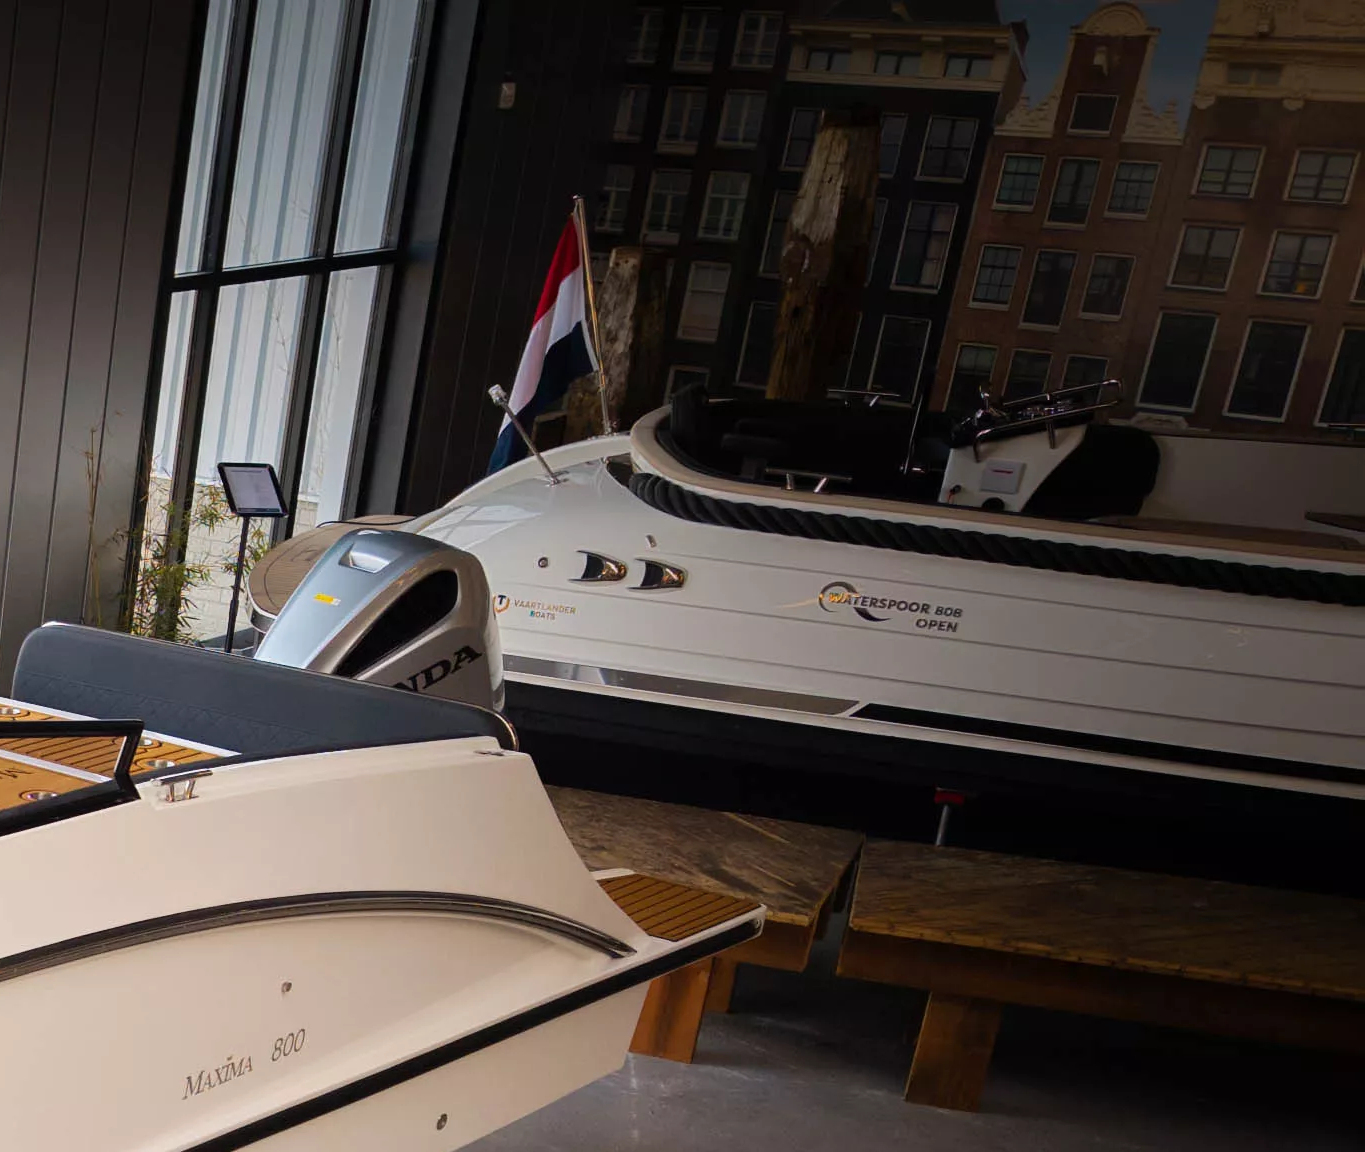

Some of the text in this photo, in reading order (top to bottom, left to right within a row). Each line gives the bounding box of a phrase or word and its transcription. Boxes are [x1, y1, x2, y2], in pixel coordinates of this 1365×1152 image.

[513, 599, 577, 615] VAARTLANDER
[828, 592, 931, 615] WATERSPOOR
[529, 610, 556, 621] BOATS
[915, 618, 959, 633] OPEN
[271, 1028, 306, 1062] 800
